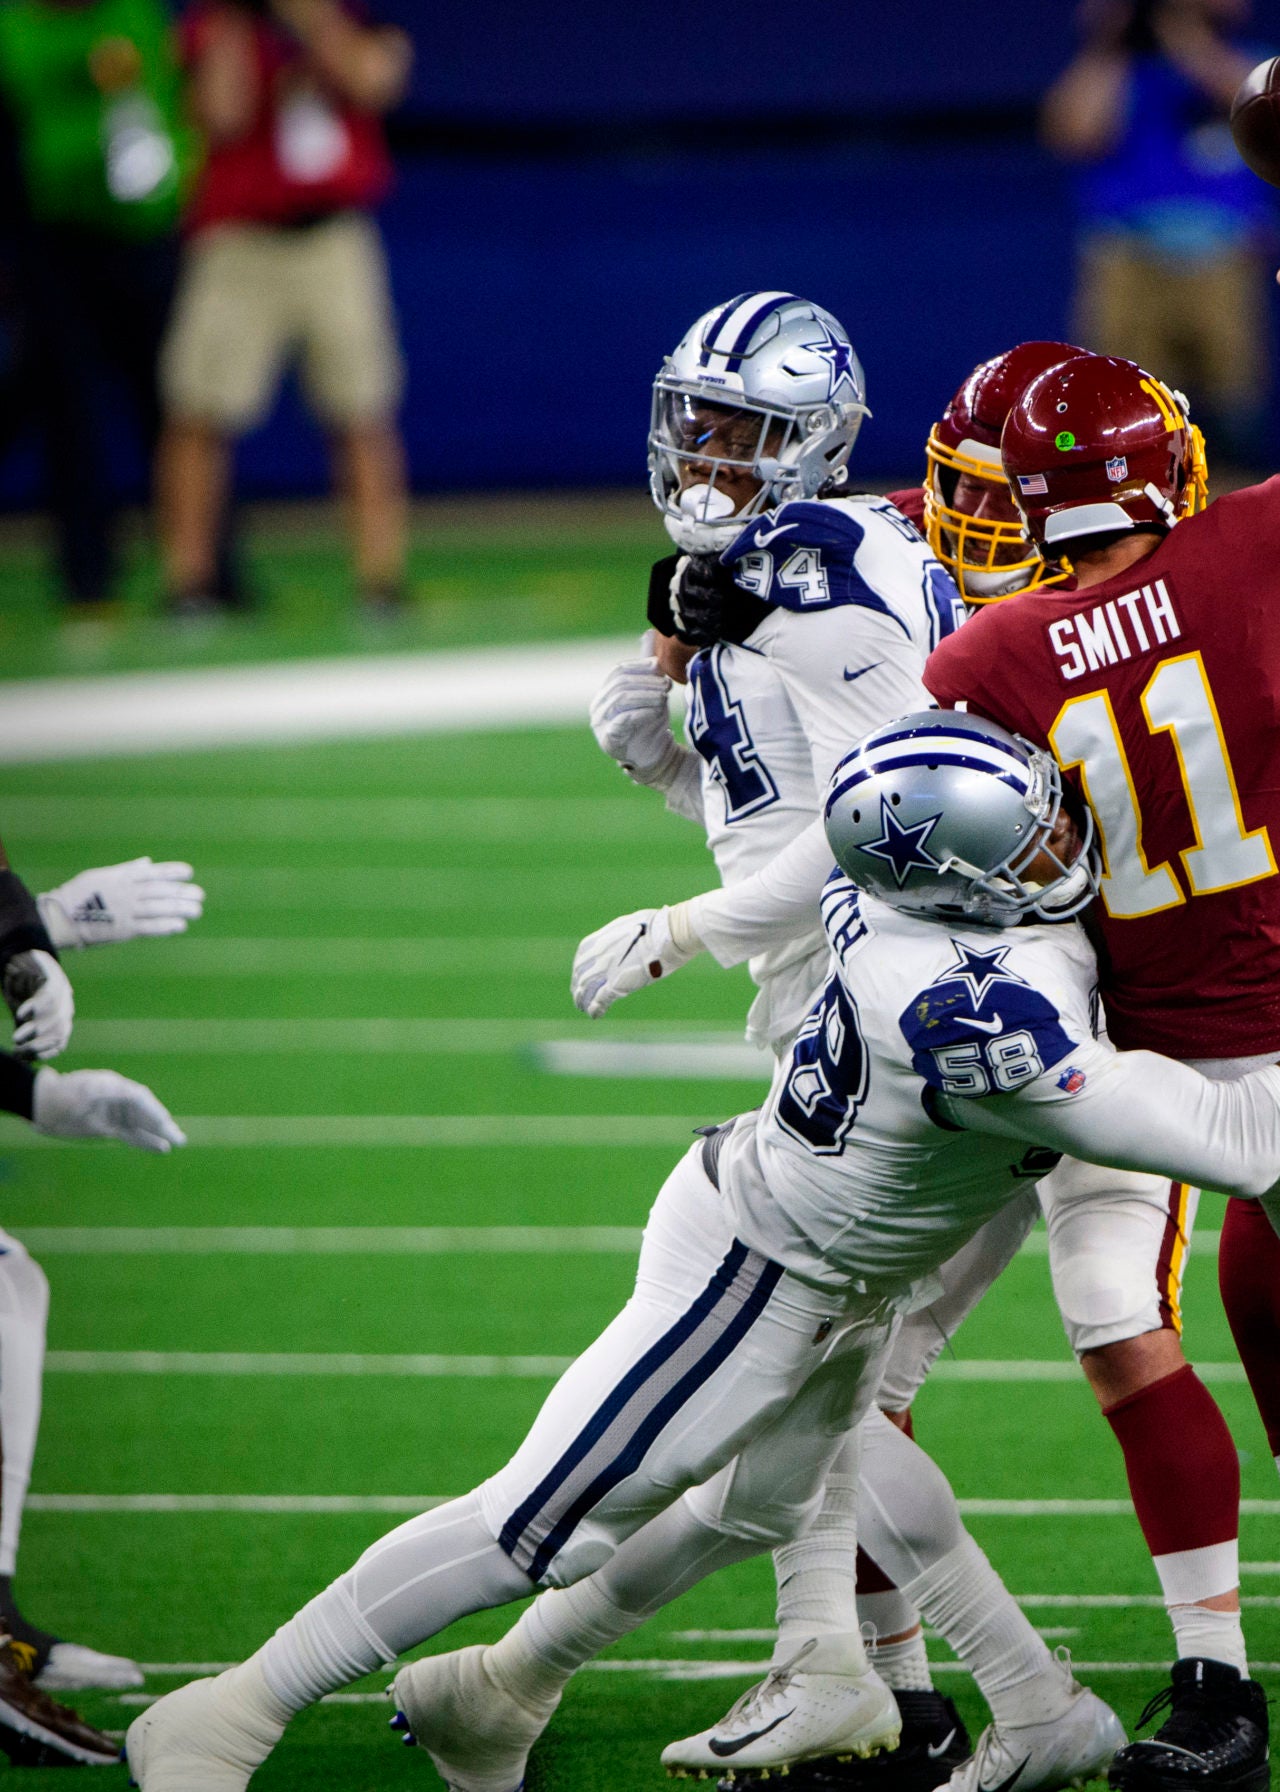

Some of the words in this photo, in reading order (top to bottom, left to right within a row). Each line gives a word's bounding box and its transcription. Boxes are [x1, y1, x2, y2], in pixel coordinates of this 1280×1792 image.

[734, 547, 831, 604] 94
[1048, 579, 1181, 681] SMITH
[1047, 650, 1280, 920] 11
[929, 1029, 1045, 1098] 58
